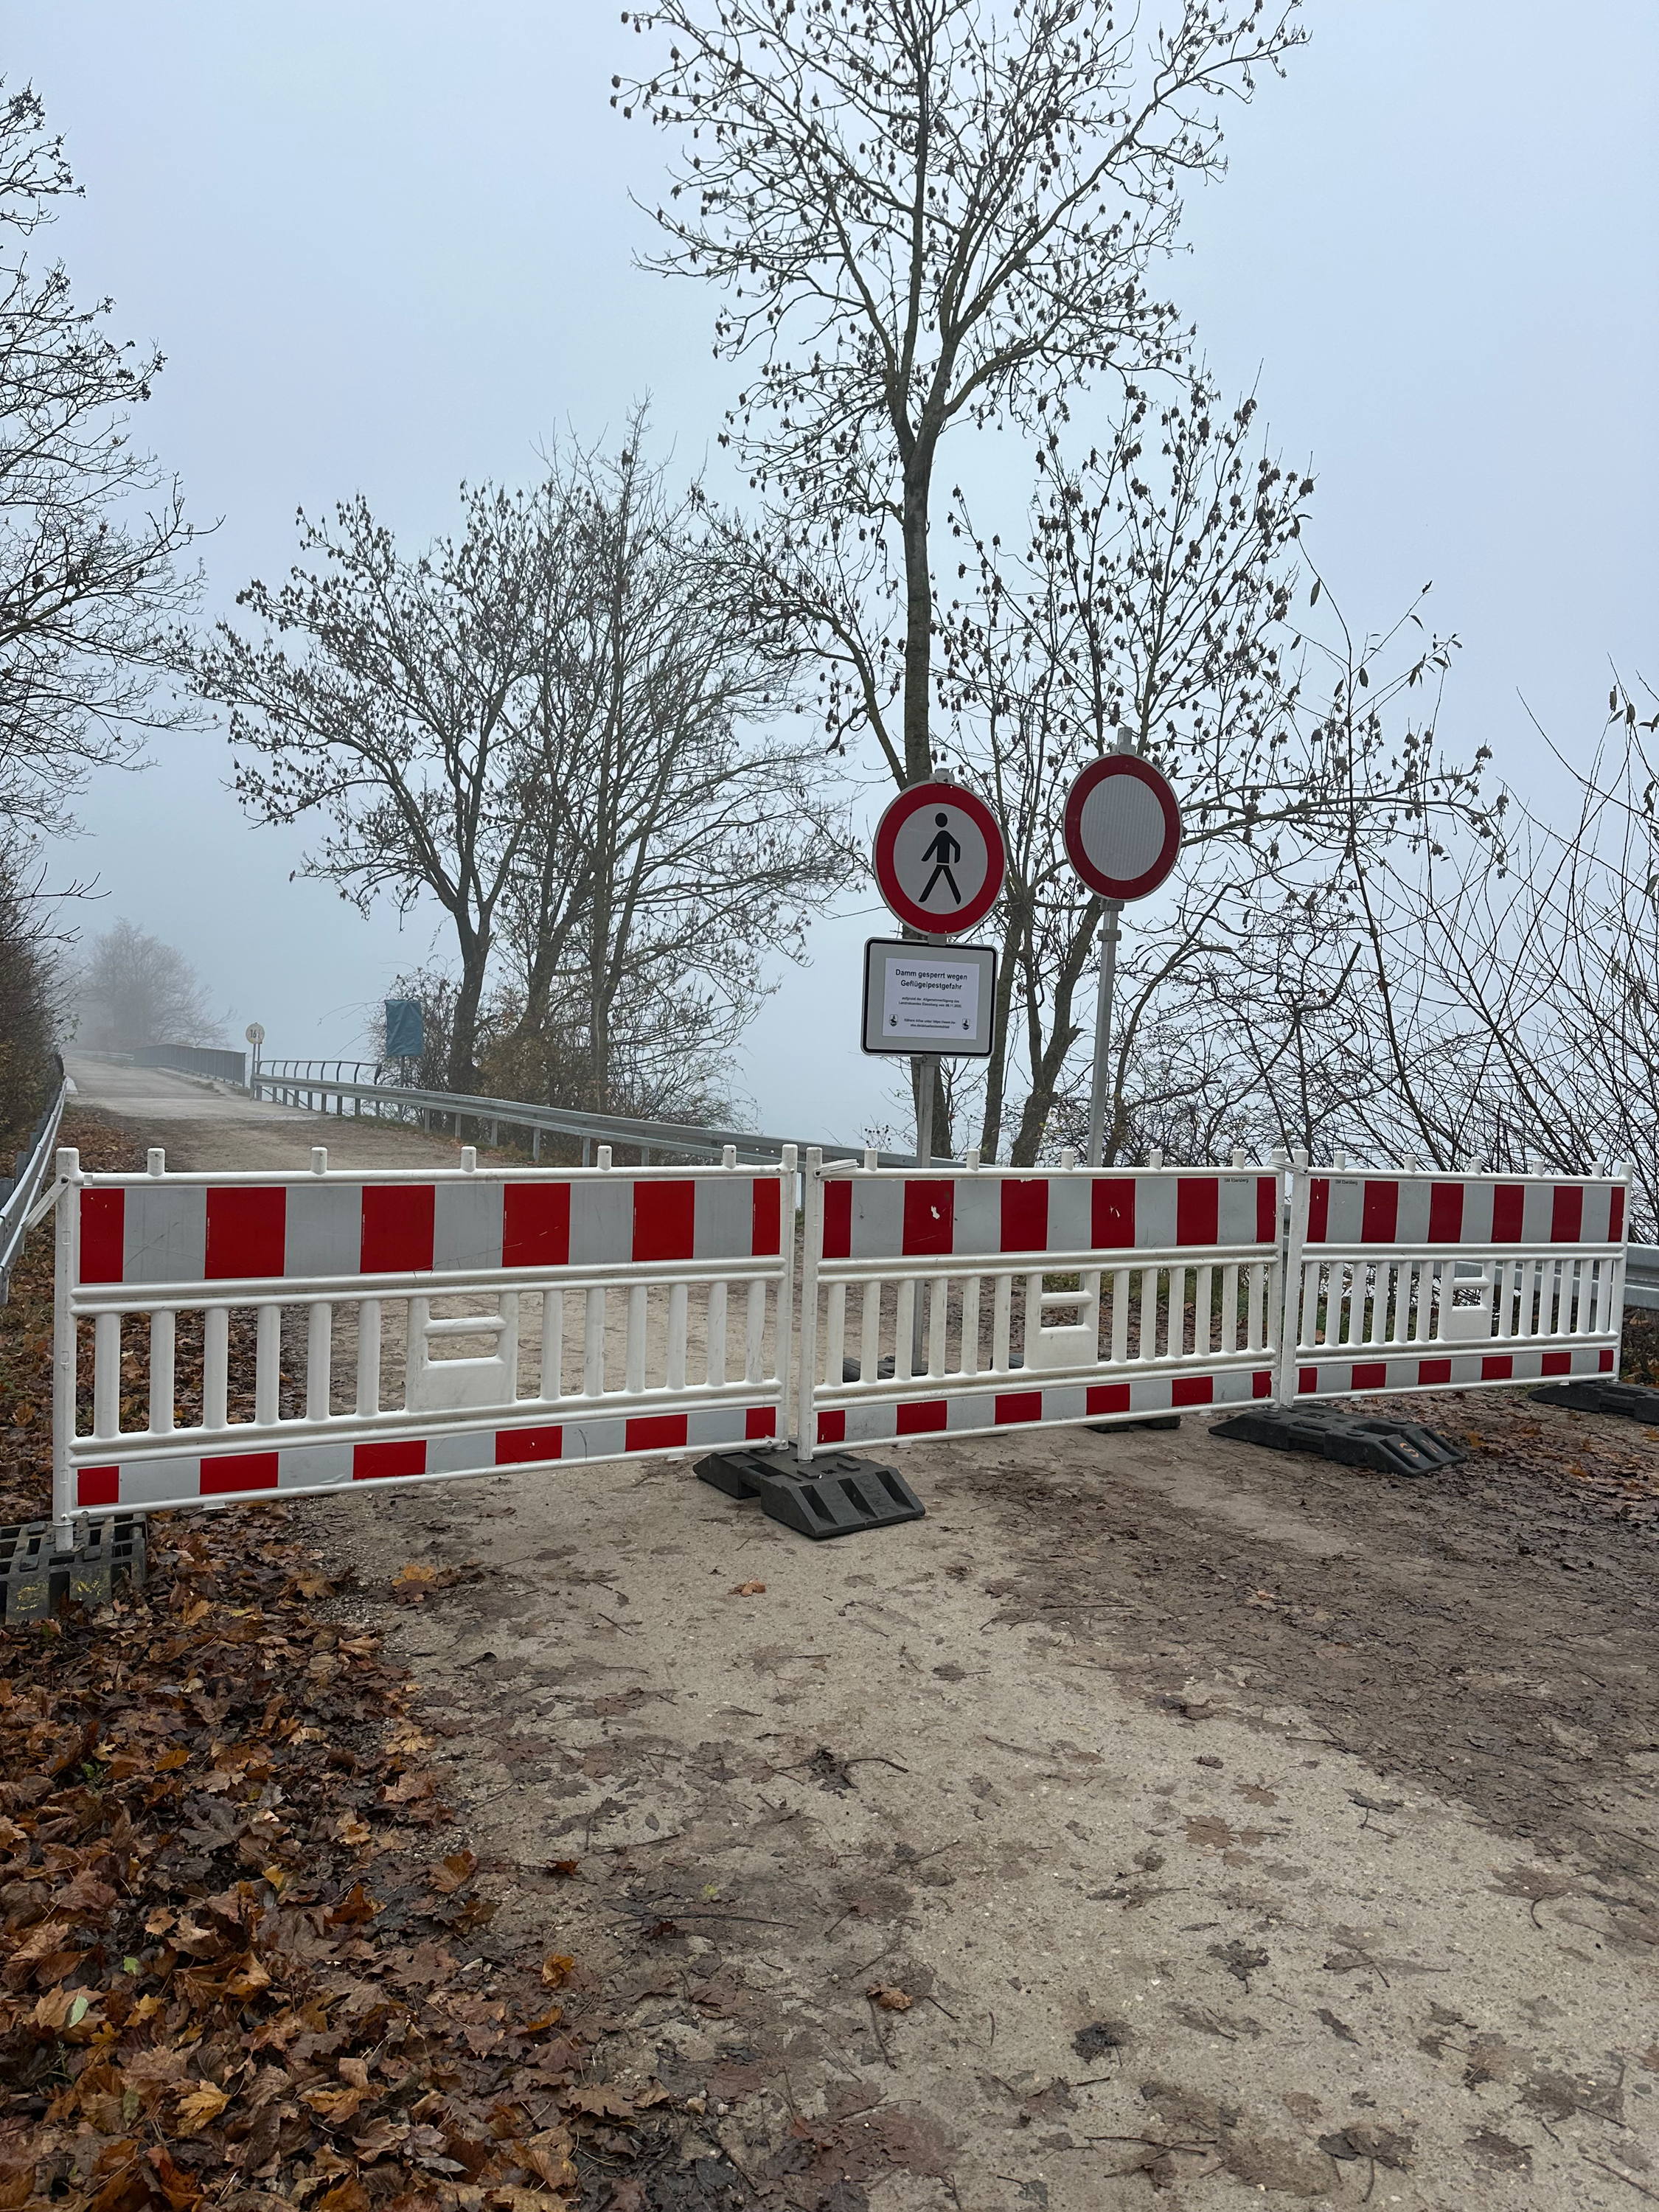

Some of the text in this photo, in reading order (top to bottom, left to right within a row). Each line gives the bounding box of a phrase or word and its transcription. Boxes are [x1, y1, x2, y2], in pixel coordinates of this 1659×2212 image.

[895, 969, 917, 977] Damm
[900, 979, 962, 990] Geflügelpestgefahr
[250, 1029, 257, 1038] 16
